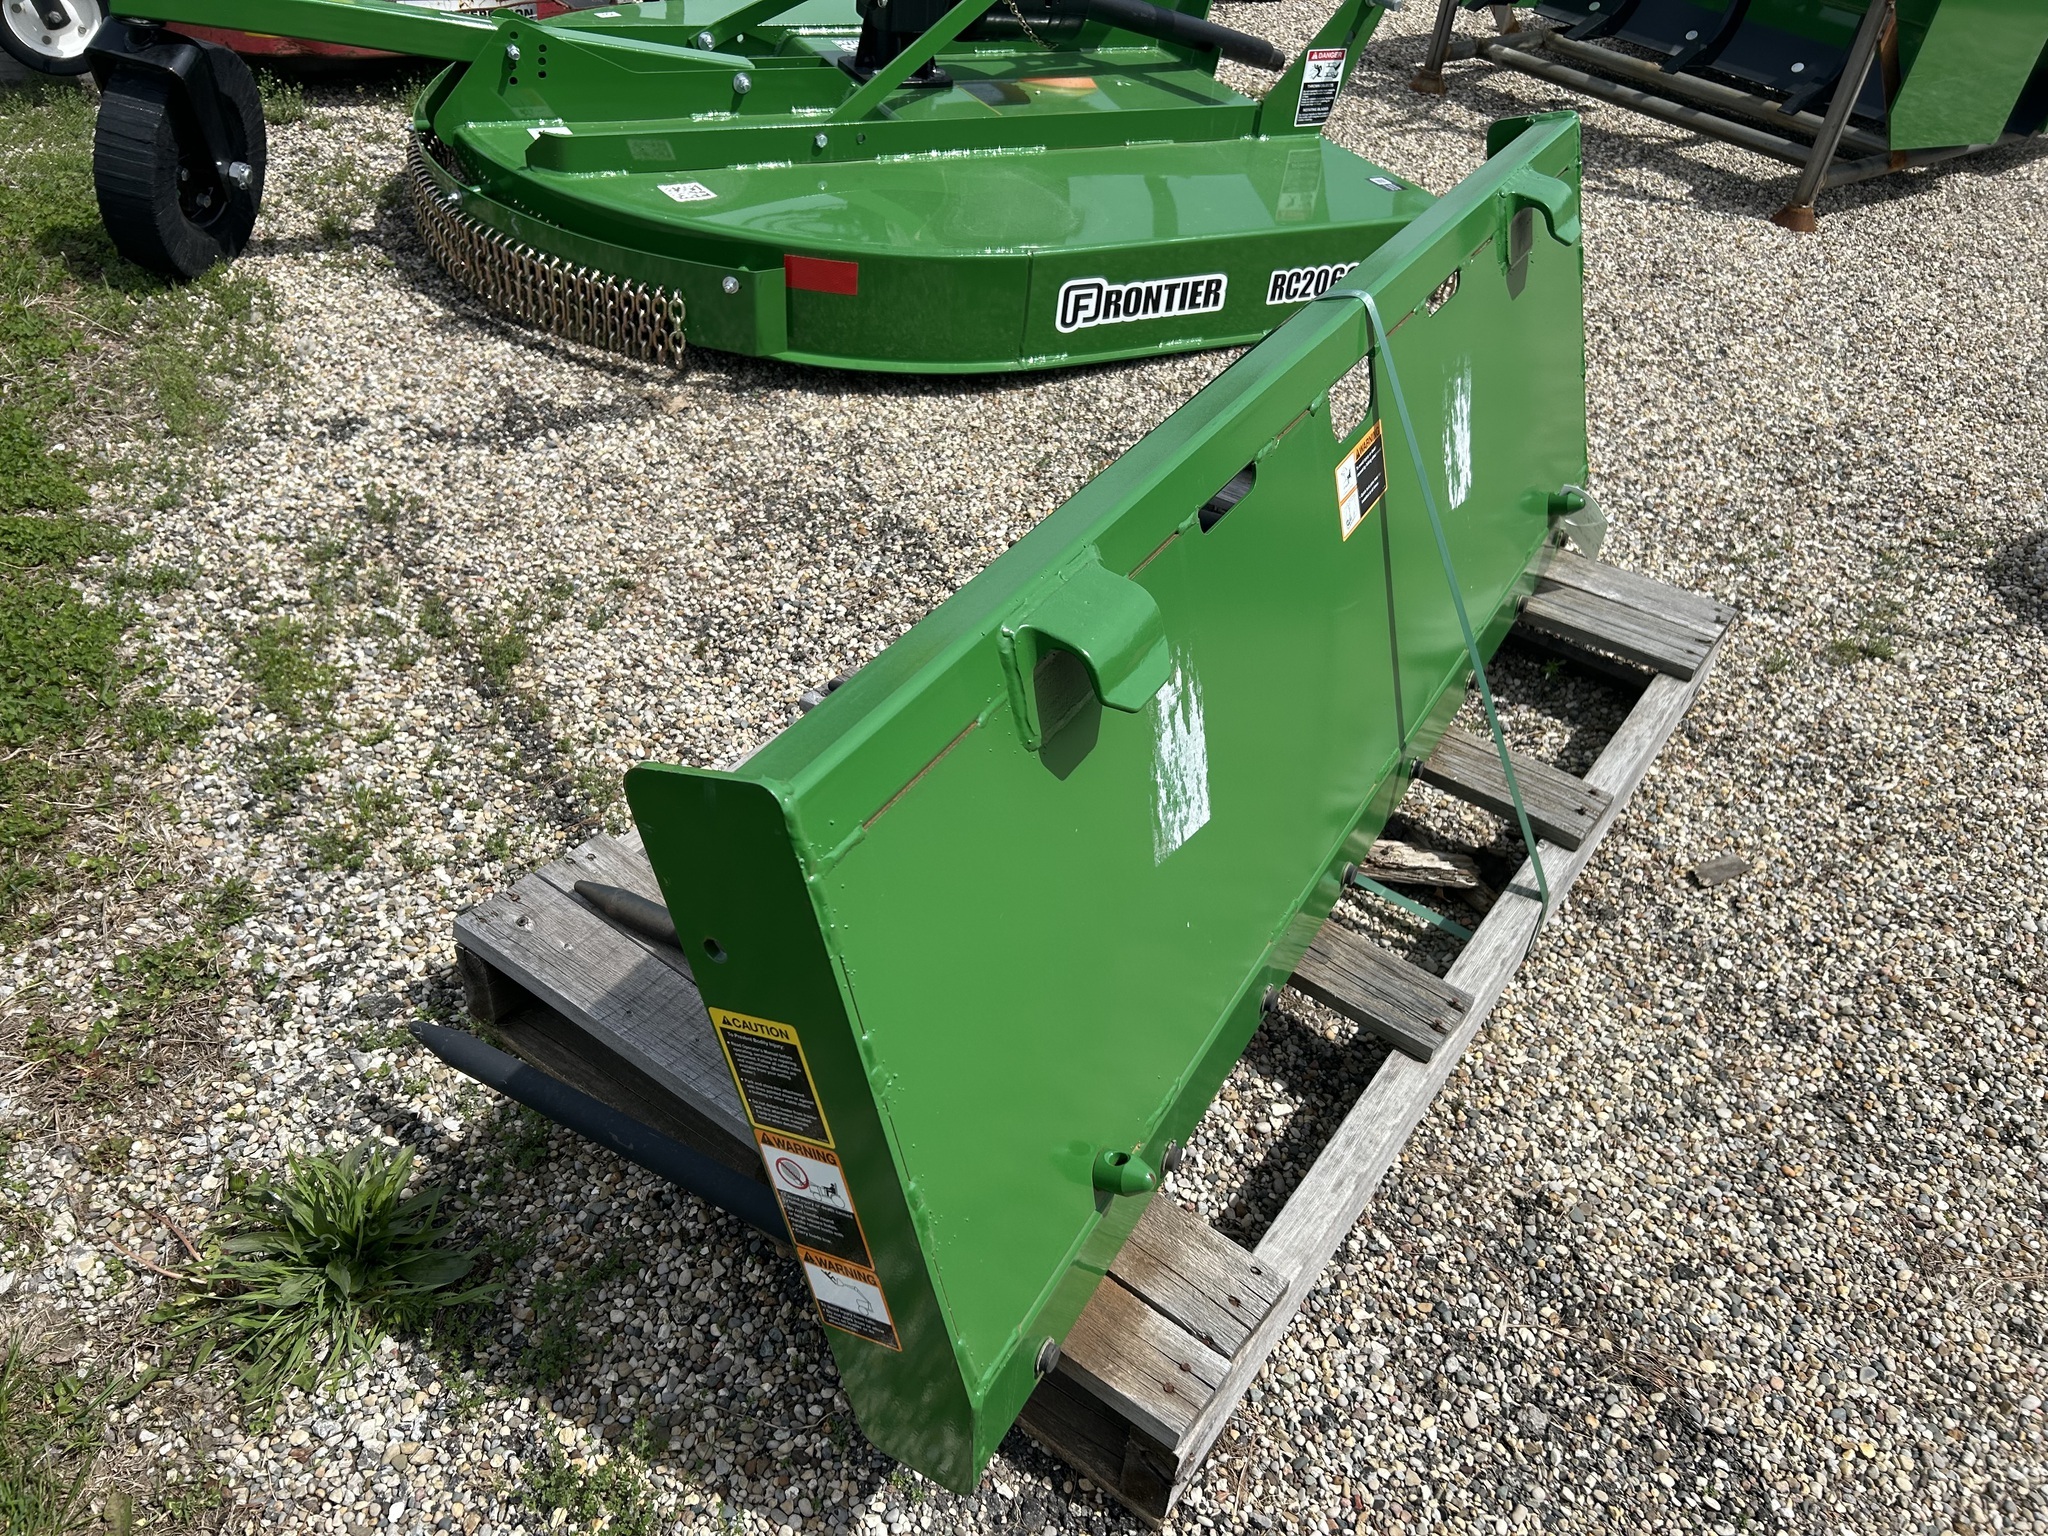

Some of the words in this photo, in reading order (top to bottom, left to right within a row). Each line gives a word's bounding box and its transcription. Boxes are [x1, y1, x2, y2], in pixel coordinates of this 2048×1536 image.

[1318, 51, 1342, 59] DANGER
[1269, 265, 1358, 302] RC206
[1061, 279, 1222, 328] FRONTIER
[731, 1018, 790, 1040] CAUTION
[772, 1135, 836, 1165] WARNING
[815, 1256, 877, 1286] WARNING
